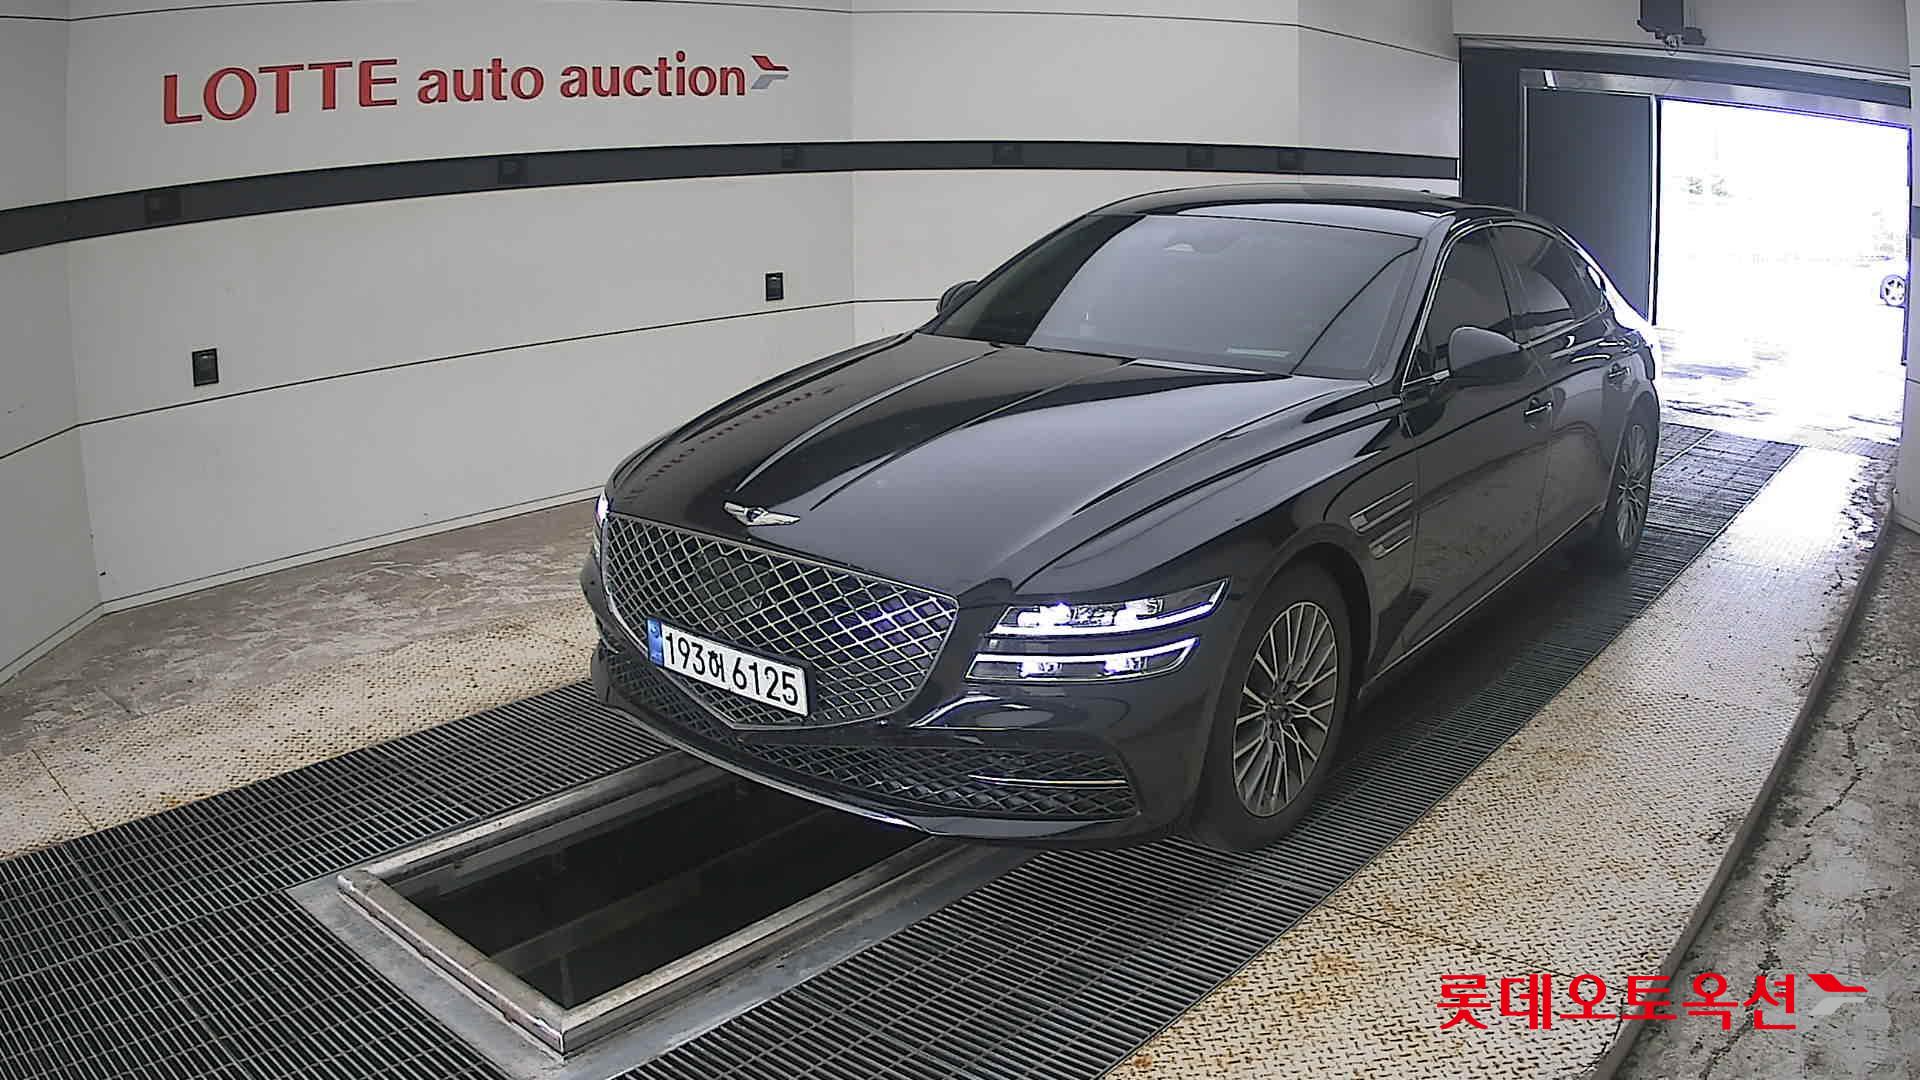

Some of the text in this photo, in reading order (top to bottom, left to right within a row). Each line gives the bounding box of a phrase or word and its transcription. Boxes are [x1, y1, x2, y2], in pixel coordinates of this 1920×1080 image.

[163, 51, 746, 124] LOTTE auto auction
[665, 632, 799, 706] 193허 6125
